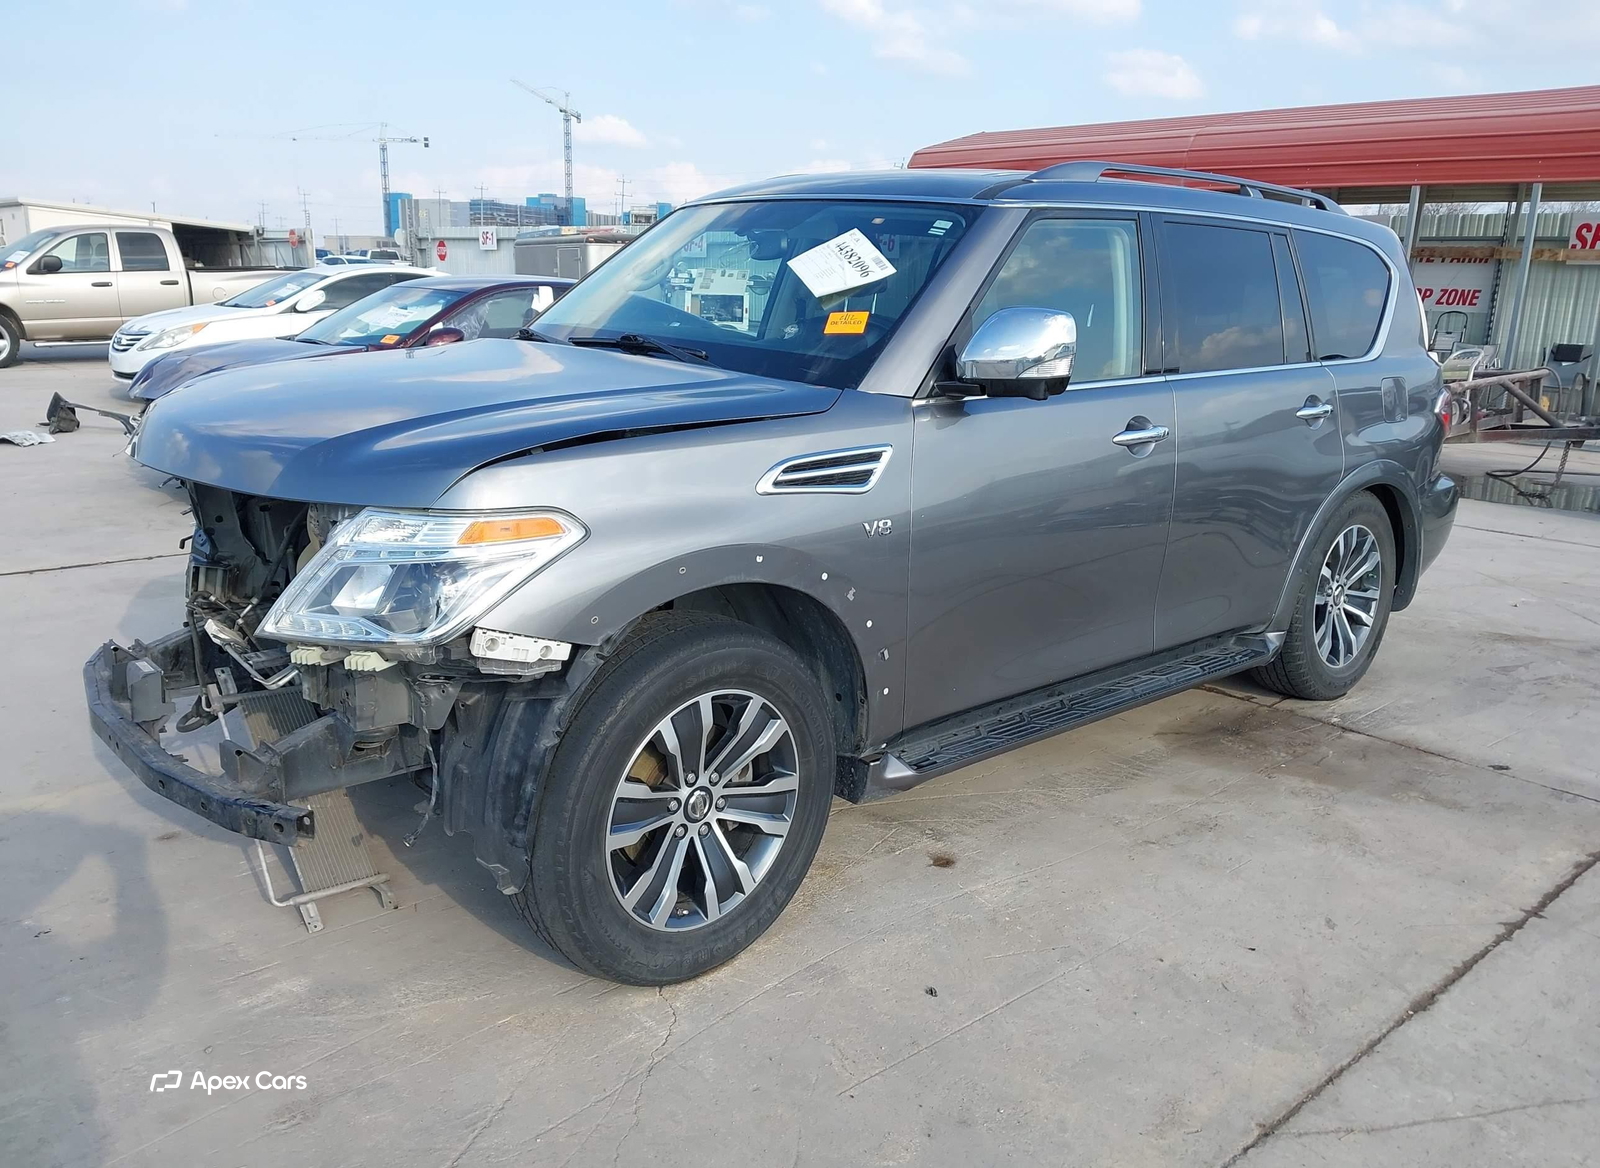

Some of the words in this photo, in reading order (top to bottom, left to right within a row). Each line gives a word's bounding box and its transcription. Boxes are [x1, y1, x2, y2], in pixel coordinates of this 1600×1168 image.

[481, 231, 494, 246] SF-1
[834, 241, 876, 278] 44382096
[1435, 288, 1482, 306] ZONE
[861, 519, 893, 538] V8
